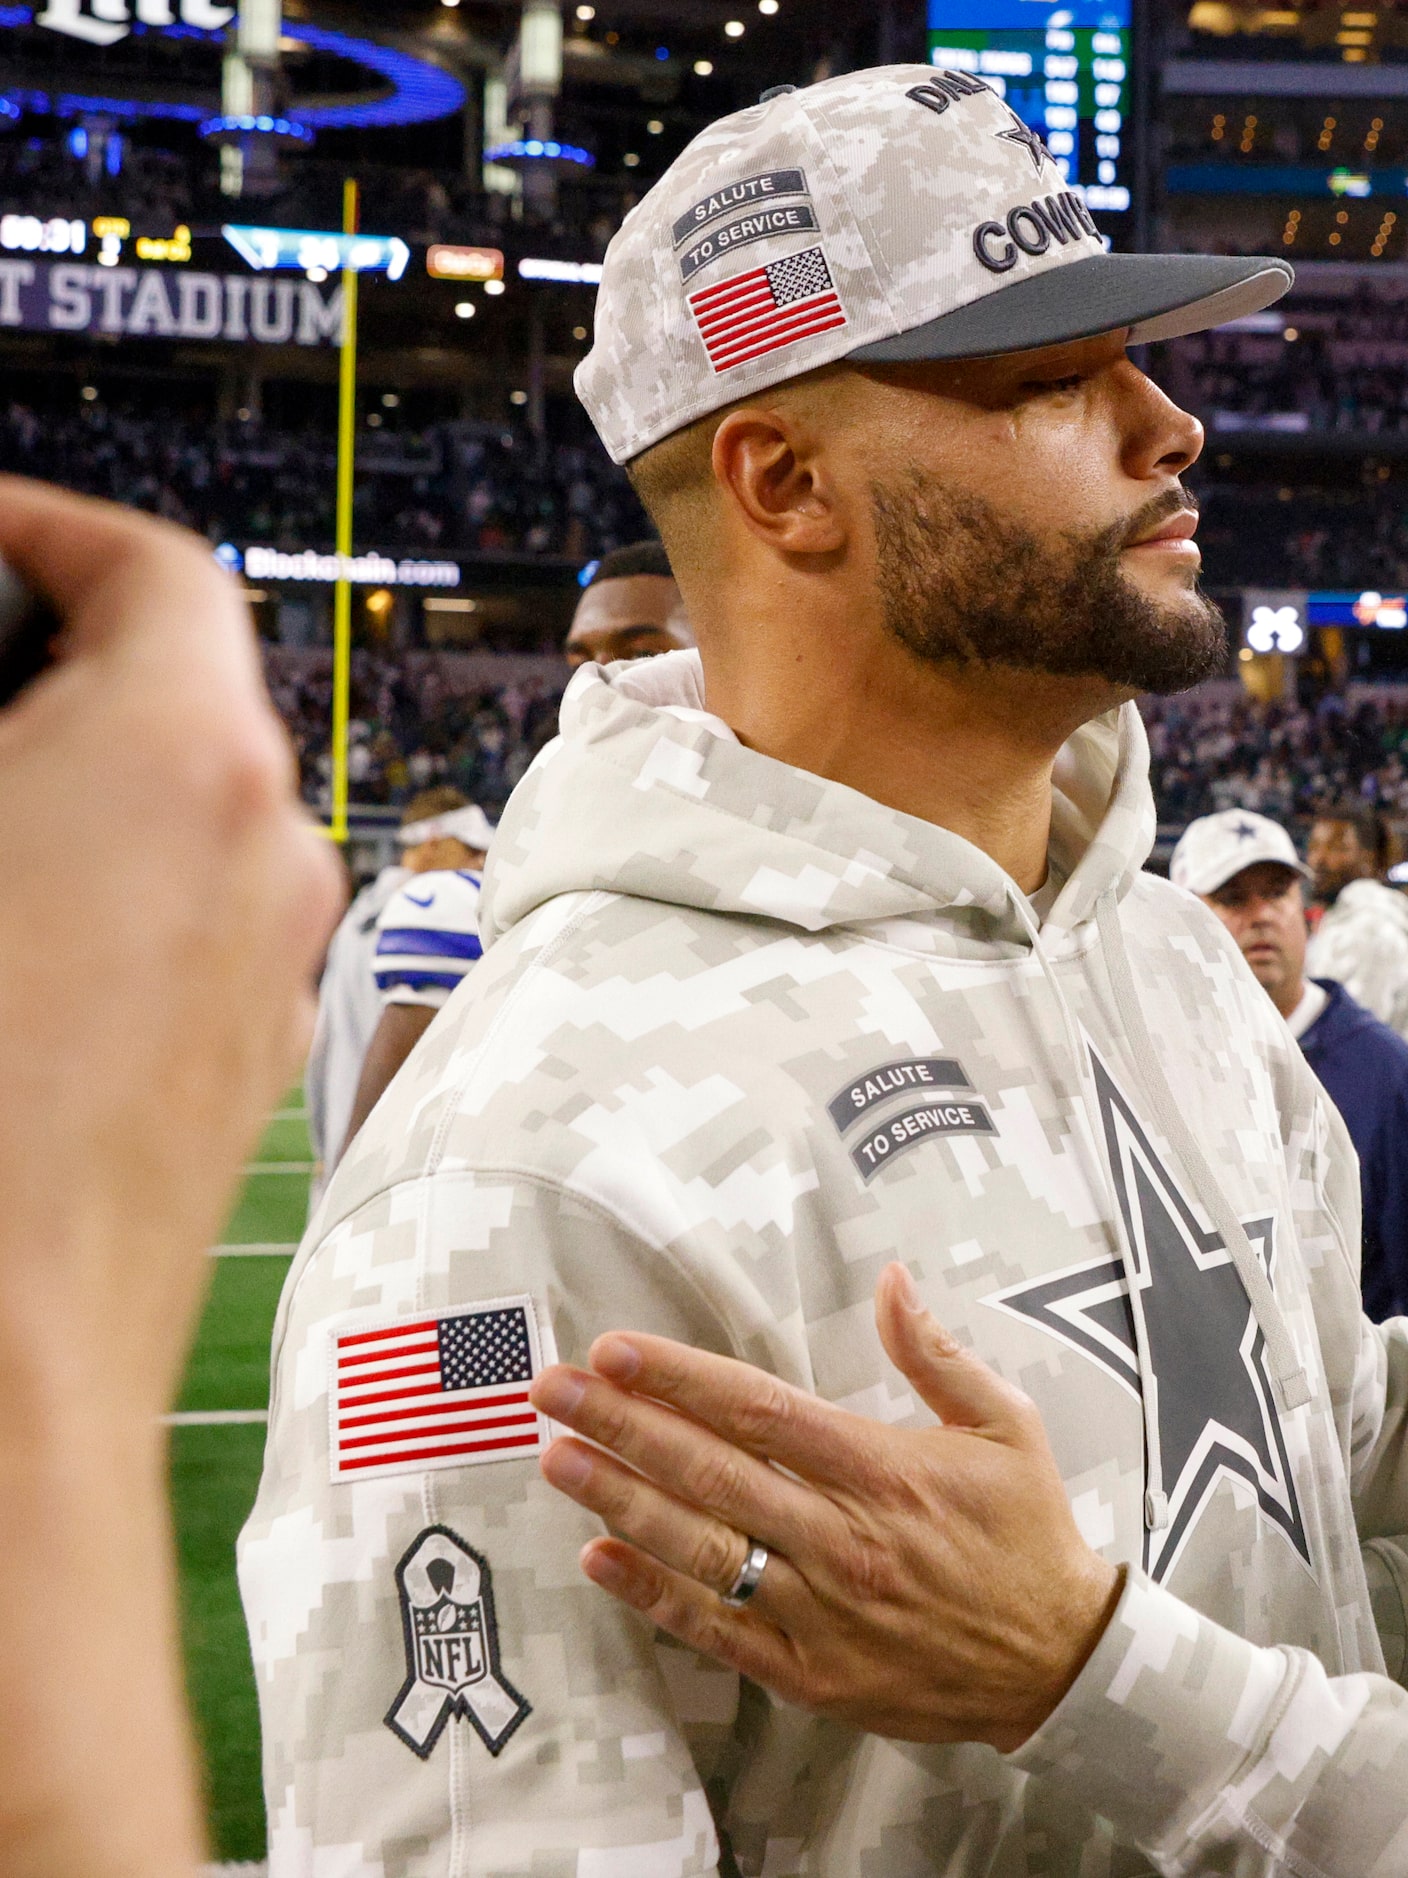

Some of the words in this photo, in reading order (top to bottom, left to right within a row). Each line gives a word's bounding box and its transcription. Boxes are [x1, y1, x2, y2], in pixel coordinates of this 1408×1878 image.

[695, 177, 775, 221] SALUTE
[689, 241, 713, 265] TO
[717, 210, 801, 247] SERVICE
[49, 263, 350, 347] STADIUM
[851, 1064, 935, 1108] SALUTE
[862, 1134, 890, 1163] TO
[890, 1107, 976, 1142] SERVICE
[421, 1635, 482, 1684] NFL
